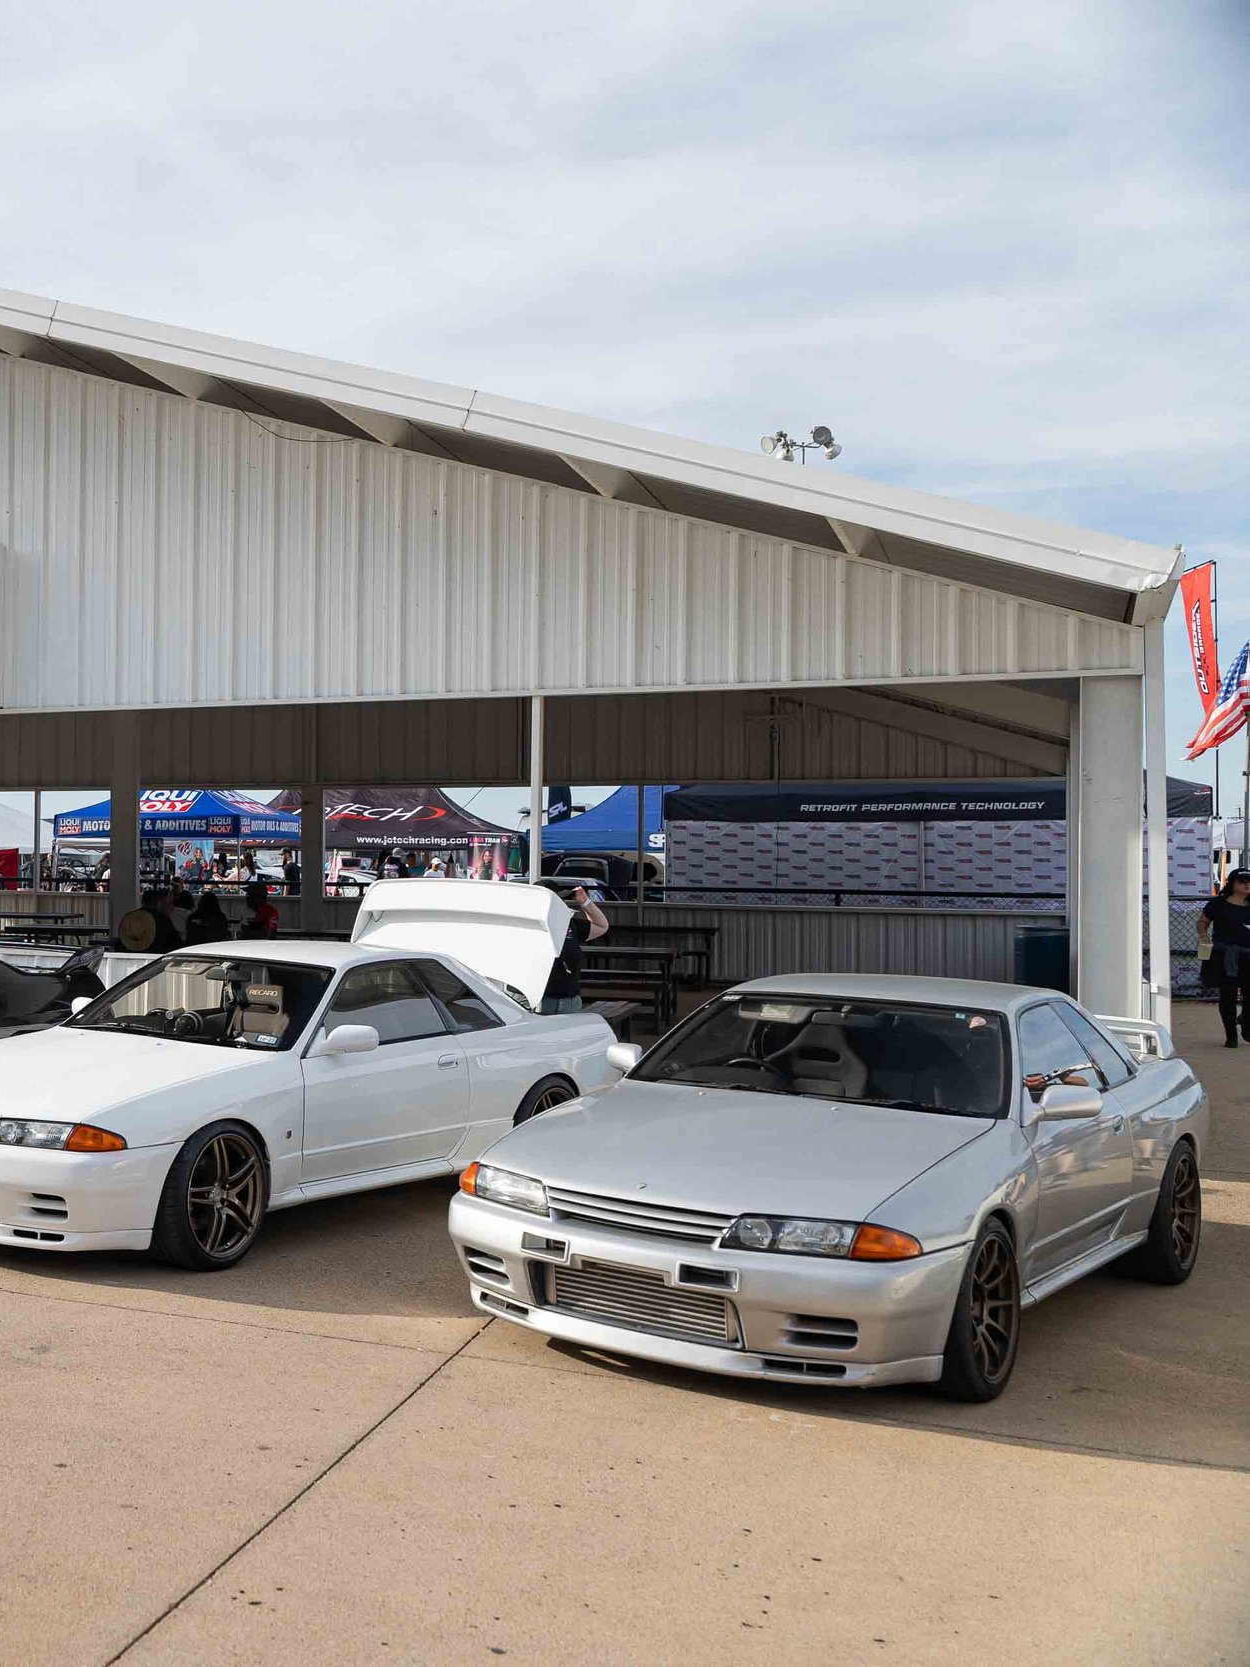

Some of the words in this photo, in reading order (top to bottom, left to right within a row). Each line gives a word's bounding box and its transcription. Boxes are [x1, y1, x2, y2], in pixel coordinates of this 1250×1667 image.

[139, 790, 199, 801] IQUI
[140, 801, 193, 811] OLY
[800, 803, 859, 812] RETROFIT
[861, 802, 957, 811] PERFORMANCE
[960, 801, 1046, 811] TECHNOLOGY
[324, 802, 424, 822] TECH
[60, 818, 80, 826] LIQUI
[82, 820, 110, 832] MOTO
[144, 819, 152, 830] &
[155, 818, 207, 831] ADDITIVES
[210, 817, 232, 825] LIQUI
[59, 826, 80, 834] MOLY
[209, 825, 232, 834] MOLY
